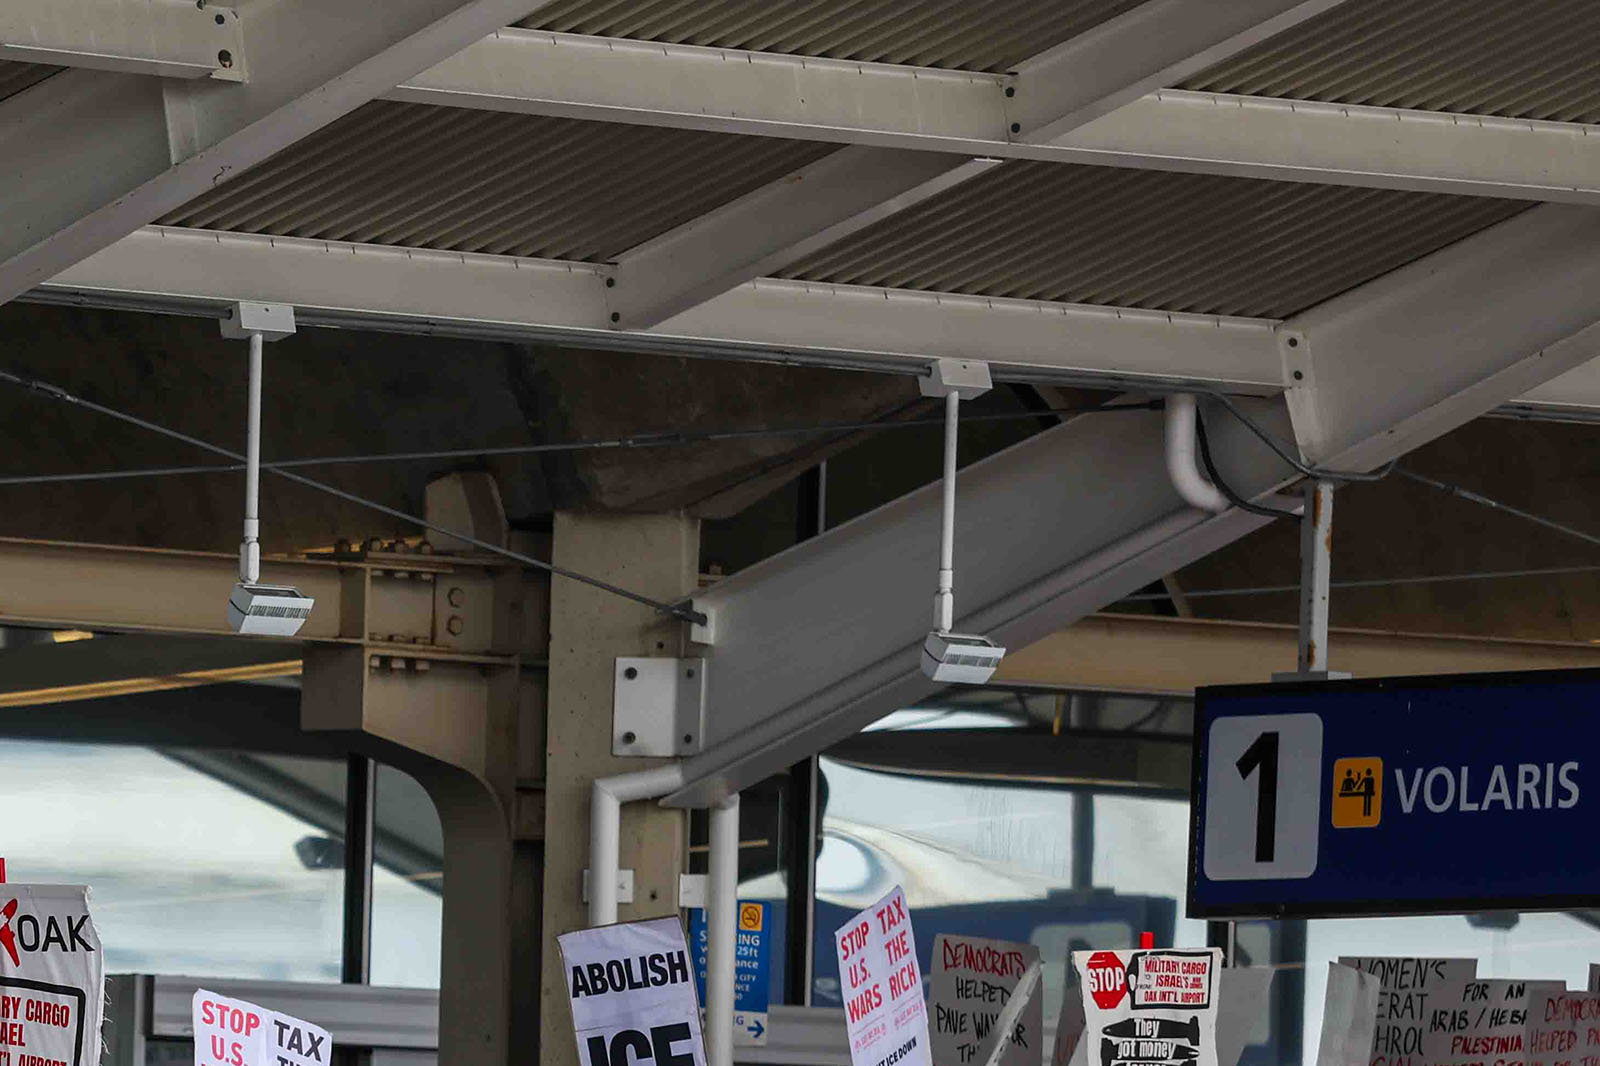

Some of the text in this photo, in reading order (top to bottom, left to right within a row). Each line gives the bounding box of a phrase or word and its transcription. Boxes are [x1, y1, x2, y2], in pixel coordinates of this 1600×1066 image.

[1235, 731, 1280, 863] 1
[1394, 761, 1581, 814] VOLARIS
[876, 896, 905, 935] TAX
[17, 914, 96, 952] OAK
[841, 921, 870, 960] STOP
[885, 930, 910, 966] THE
[571, 950, 688, 998] ABOLISH
[849, 958, 871, 989] U.S.
[943, 938, 1026, 980] DEMOCRATS
[1144, 959, 1179, 974] MILITARY
[1181, 961, 1207, 975] CARGO
[889, 961, 917, 1001] RICH
[1087, 967, 1125, 992] STOP
[1462, 983, 1525, 1002] FOR AN
[25, 999, 71, 1029] CARGO
[847, 984, 883, 1024] WARS
[1144, 991, 1157, 1002] OAK
[1181, 992, 1205, 1003] AIRPORT
[201, 1000, 260, 1037] STOP
[935, 1002, 968, 1034] PAVE
[1134, 1019, 1160, 1039] They
[1430, 1009, 1469, 1033] ARAB
[274, 1019, 325, 1062] TAX
[898, 1036, 917, 1059] DOWN
[1117, 1041, 1177, 1059] got money
[1451, 1034, 1524, 1055] PALESTINIA
